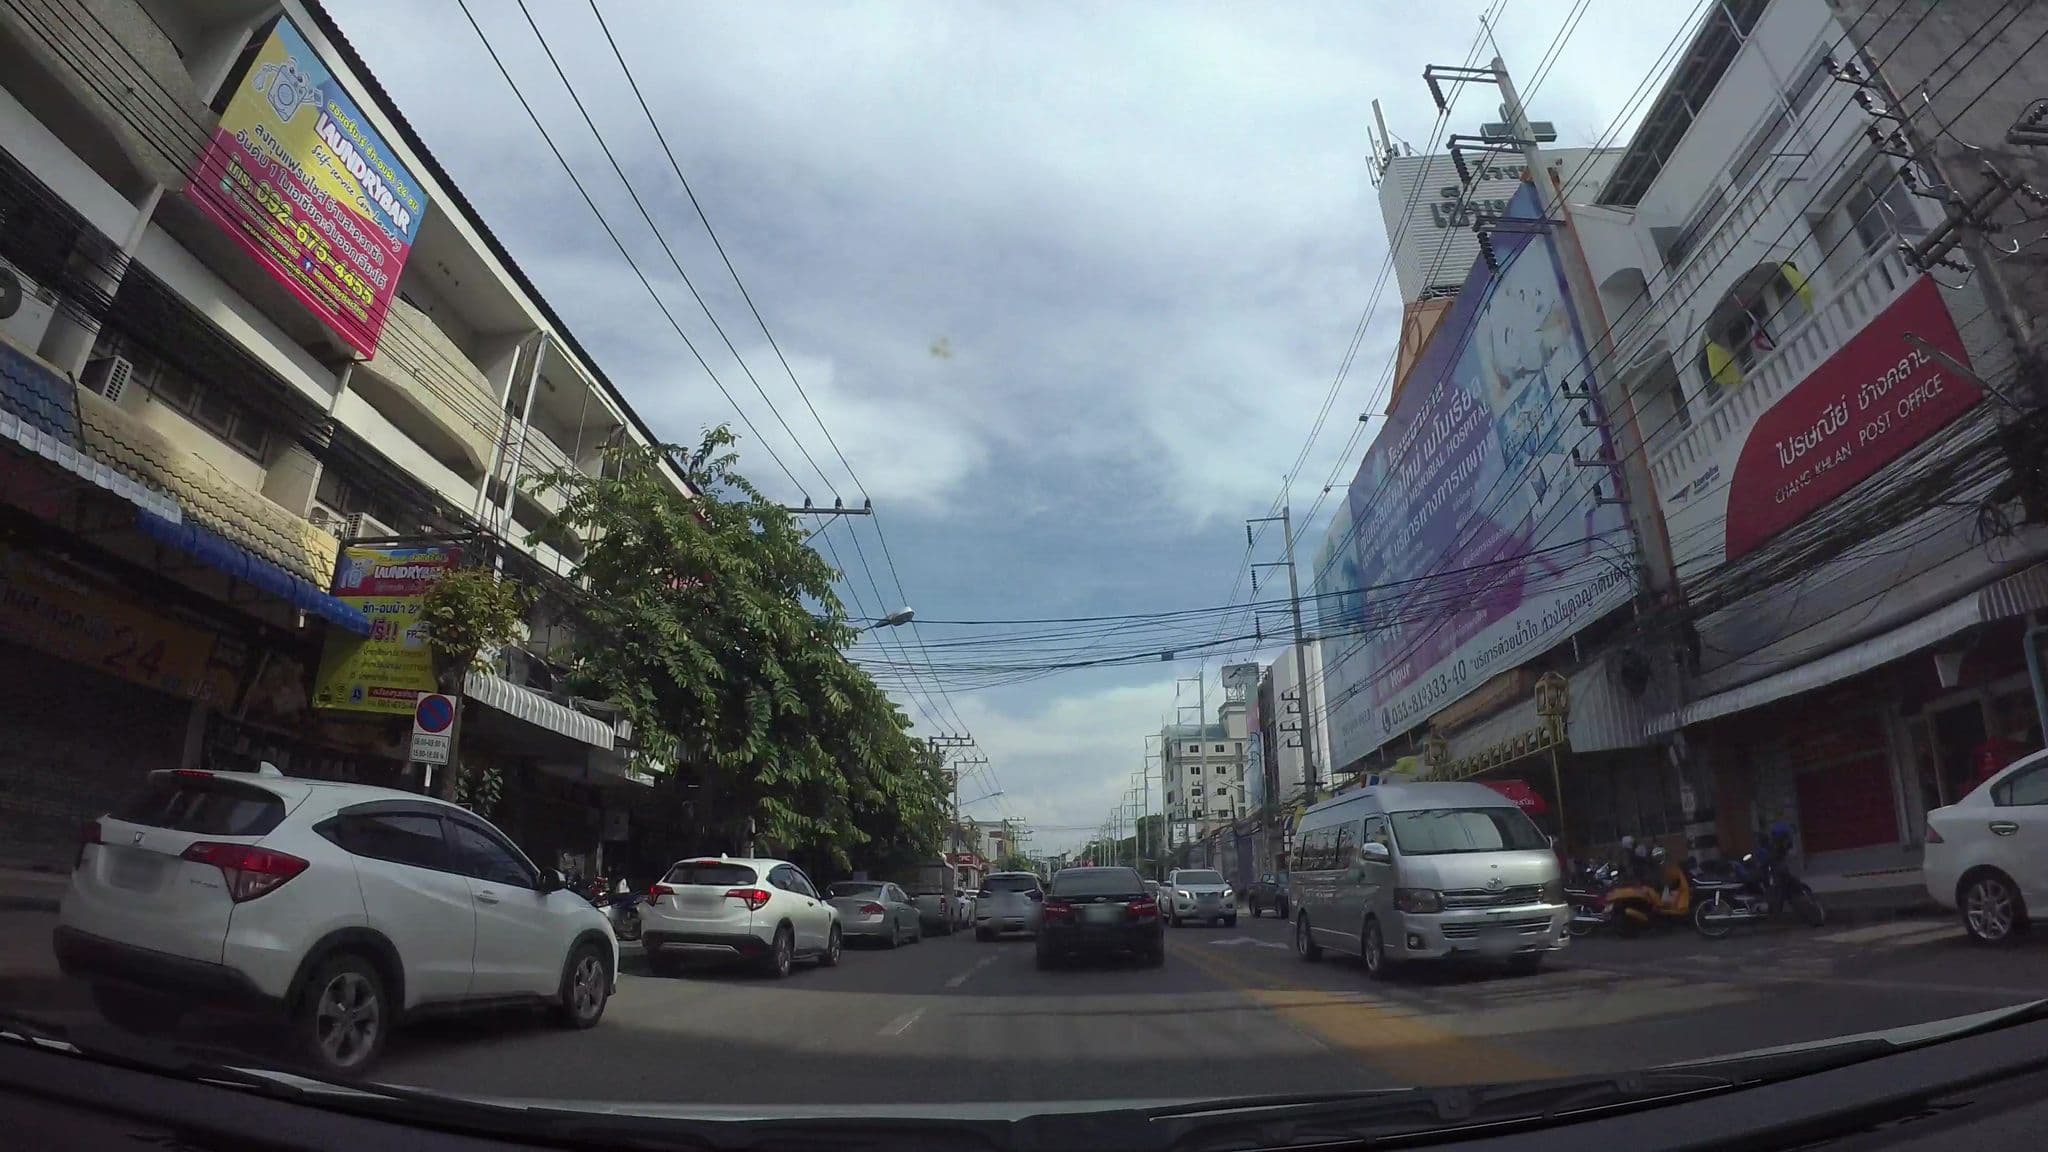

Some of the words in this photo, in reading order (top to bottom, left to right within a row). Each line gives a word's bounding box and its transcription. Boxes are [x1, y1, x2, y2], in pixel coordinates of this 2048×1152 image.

[234, 127, 269, 168] อันดับ
[268, 163, 277, 176] 1
[313, 111, 411, 235] LAUNDRYBAR
[256, 181, 373, 305] 092-675-4455
[1409, 453, 1445, 503] MEMORIAL
[1448, 402, 1489, 456] HOSPITAL
[1775, 470, 1811, 504] CHANG
[1814, 444, 1852, 478] KHLAN
[1858, 411, 1891, 446] POST
[1897, 374, 1944, 418] OFFICE
[1776, 395, 1849, 468] ไปรษณีย์
[102, 623, 166, 681] 24
[1391, 660, 1467, 726] 053-819333-40
